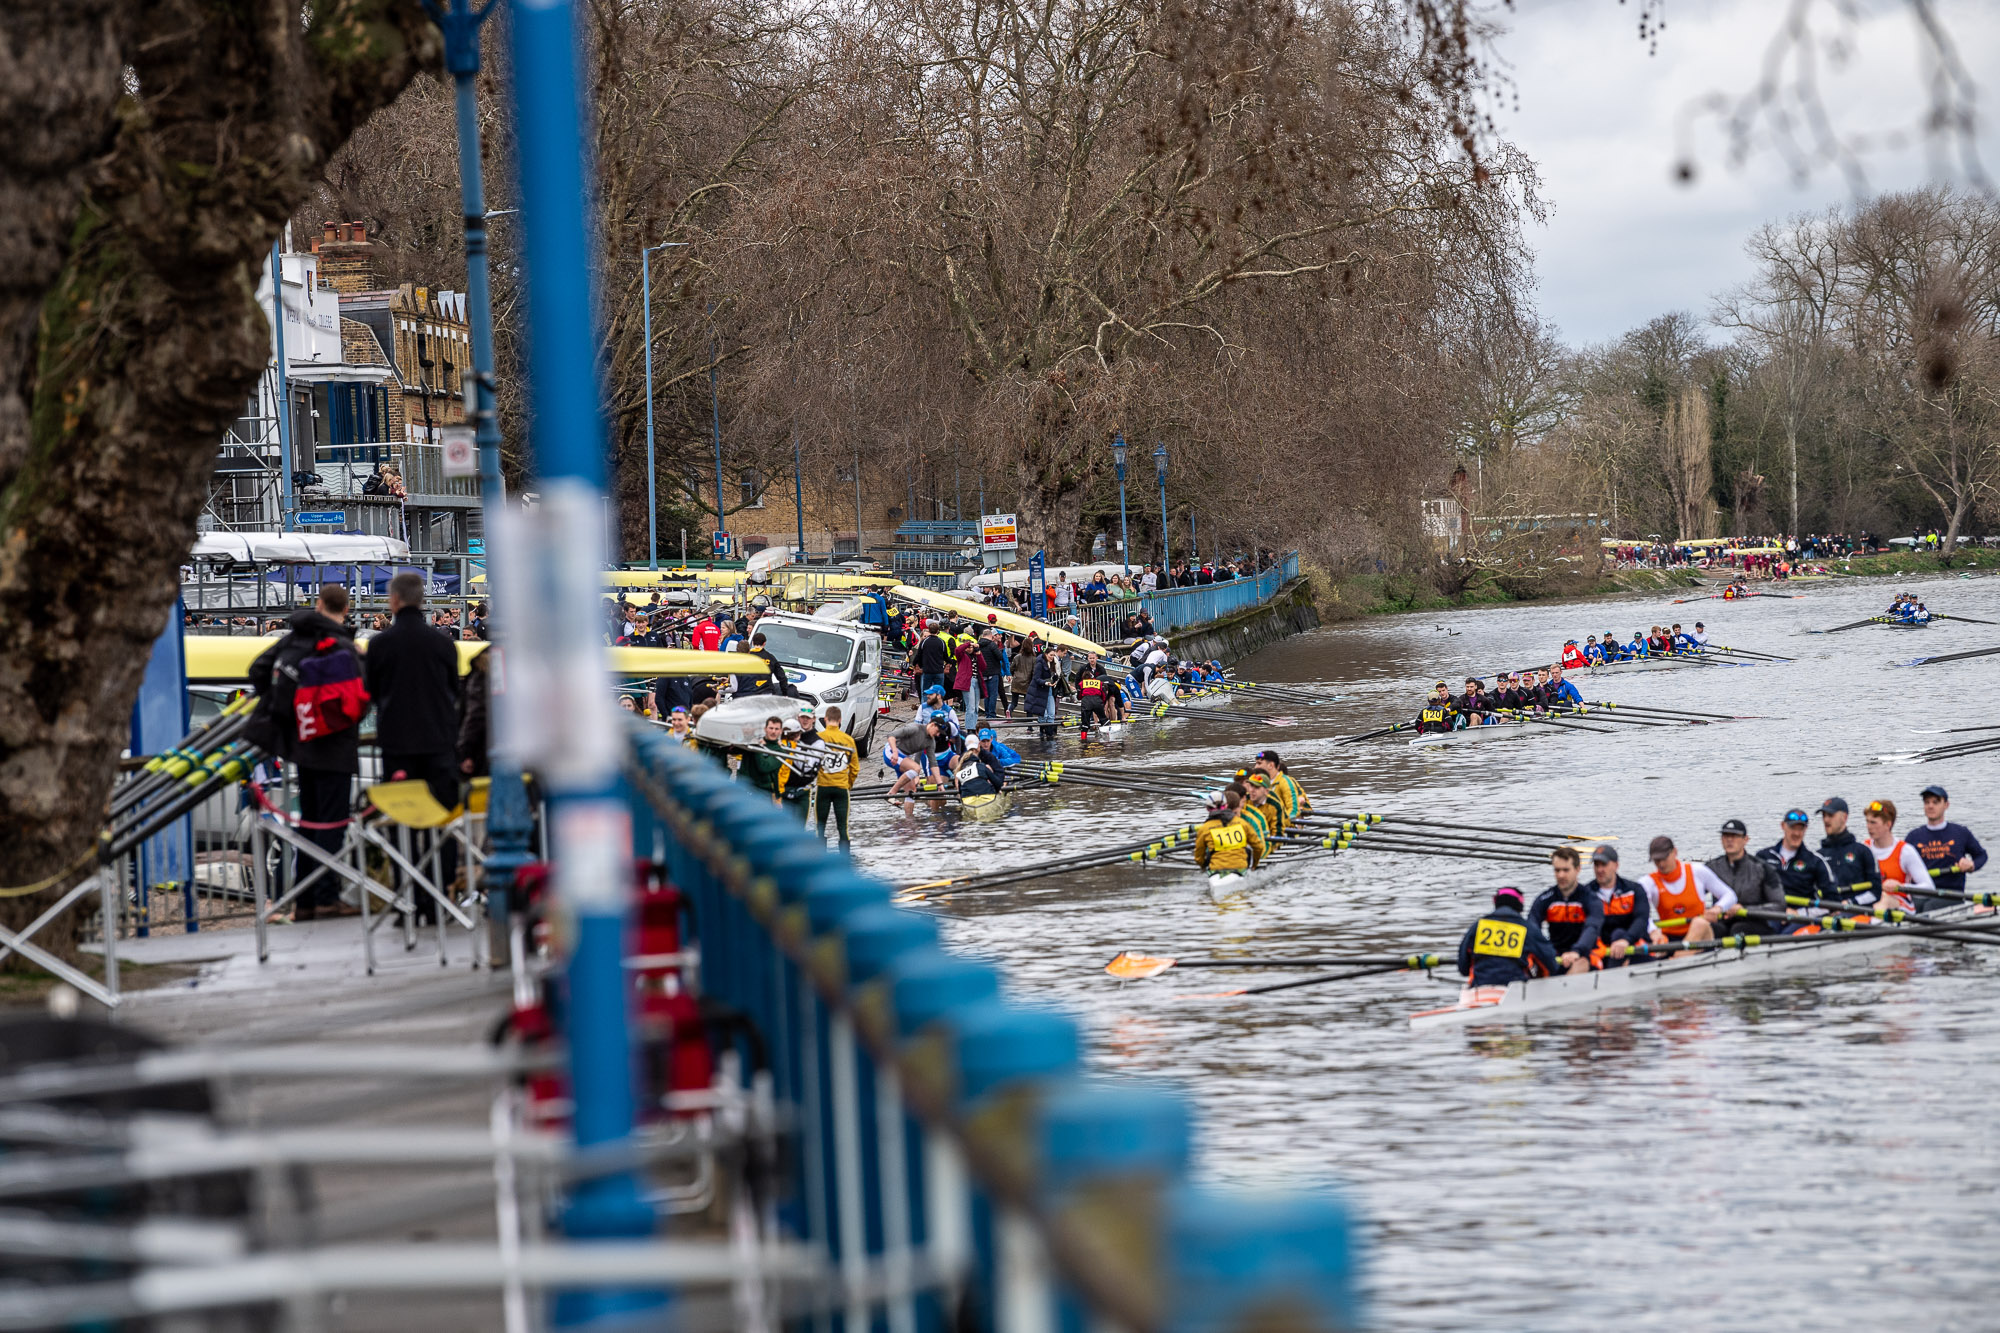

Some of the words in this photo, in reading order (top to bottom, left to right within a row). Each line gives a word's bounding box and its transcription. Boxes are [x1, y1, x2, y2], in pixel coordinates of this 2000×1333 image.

[1085, 680, 1099, 688] 102
[1425, 710, 1441, 719] 120
[960, 768, 972, 780] 69
[1216, 829, 1243, 847] 110
[1920, 845, 1950, 854] ROWING
[1926, 852, 1945, 860] CLUB
[1479, 927, 1520, 949] 236
